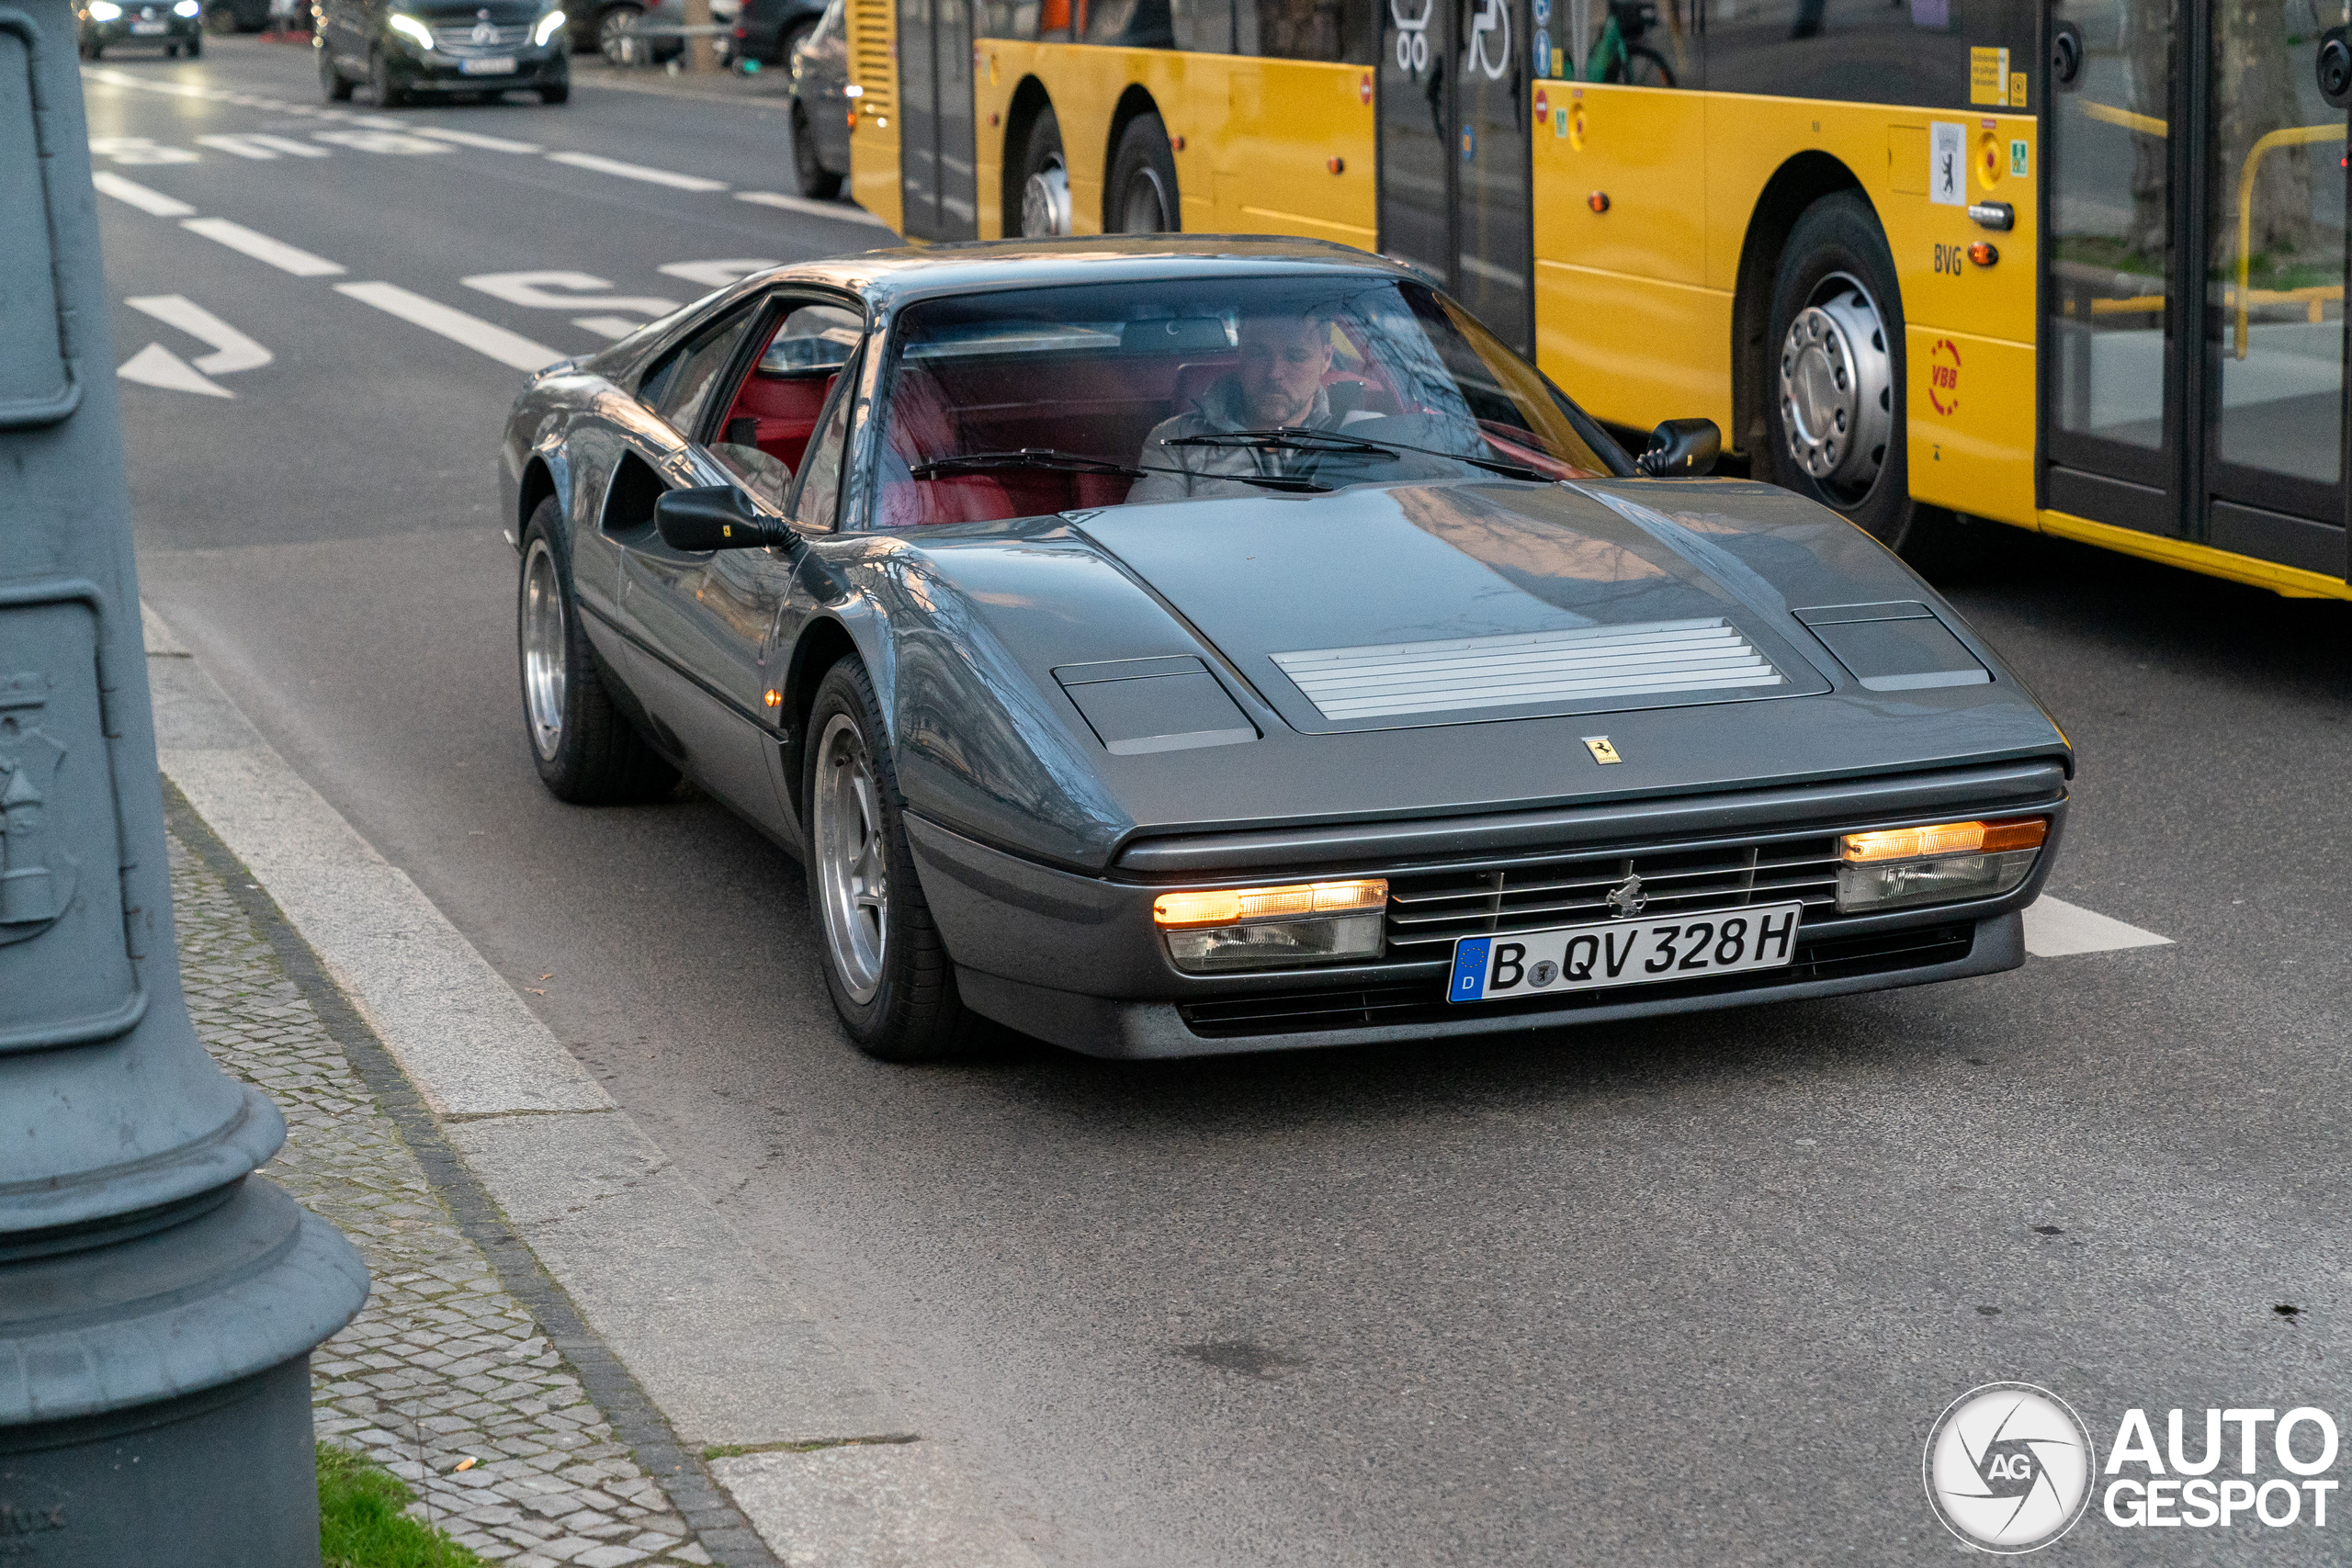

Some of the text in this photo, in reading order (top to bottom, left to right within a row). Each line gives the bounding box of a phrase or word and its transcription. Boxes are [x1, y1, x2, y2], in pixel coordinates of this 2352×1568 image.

[1934, 243, 1962, 276] BVG
[1932, 365, 1957, 389] VBB
[1489, 942, 1526, 991] B
[1563, 930, 1638, 982] QV
[1755, 911, 1794, 962] H
[1462, 976, 1475, 990] D
